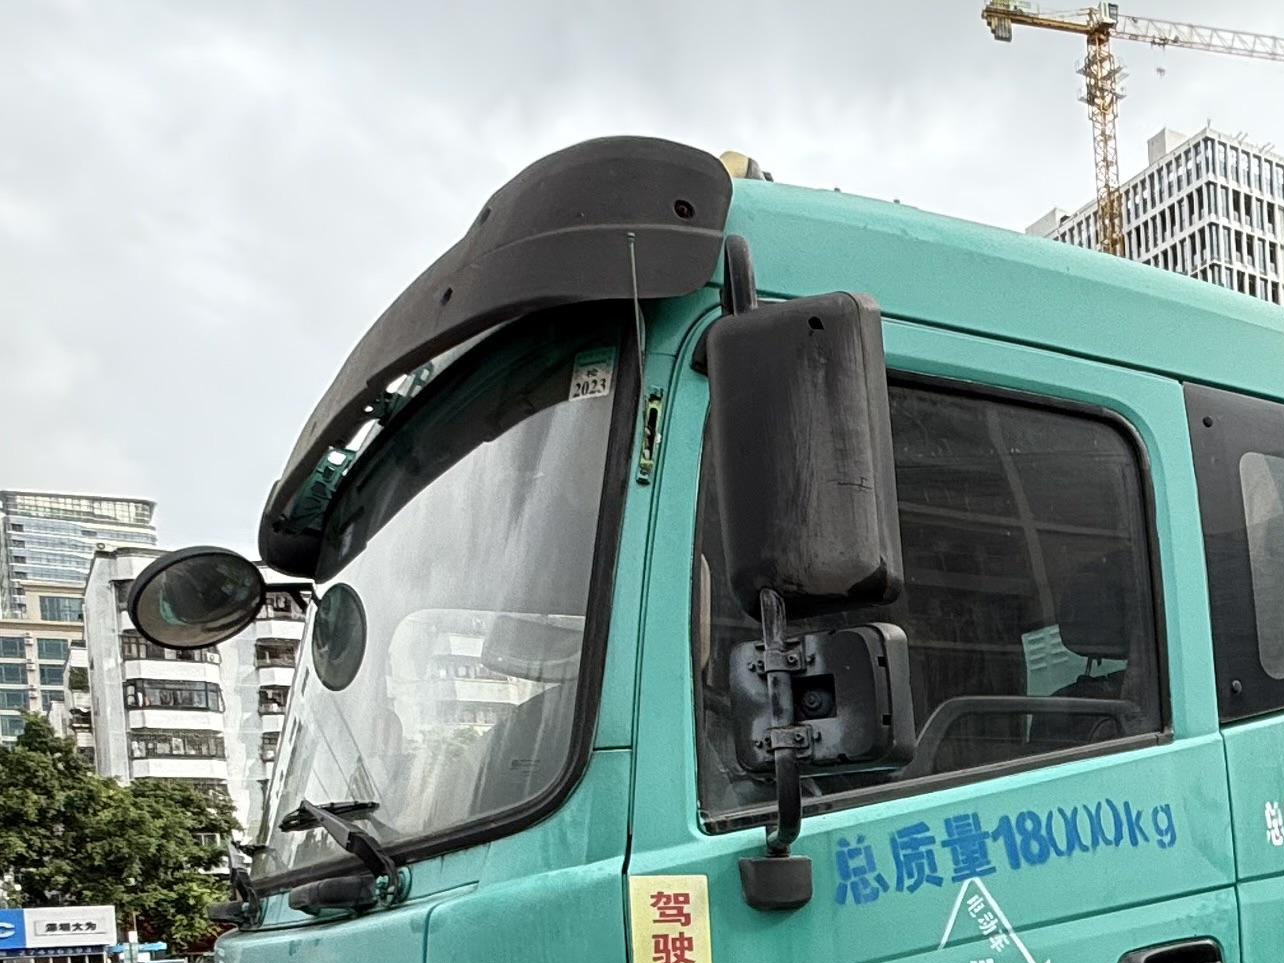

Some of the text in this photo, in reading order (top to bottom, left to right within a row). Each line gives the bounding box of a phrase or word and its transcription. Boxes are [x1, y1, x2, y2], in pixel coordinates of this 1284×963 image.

[572, 378, 607, 398] 2023
[967, 894, 1010, 953] 电动车
